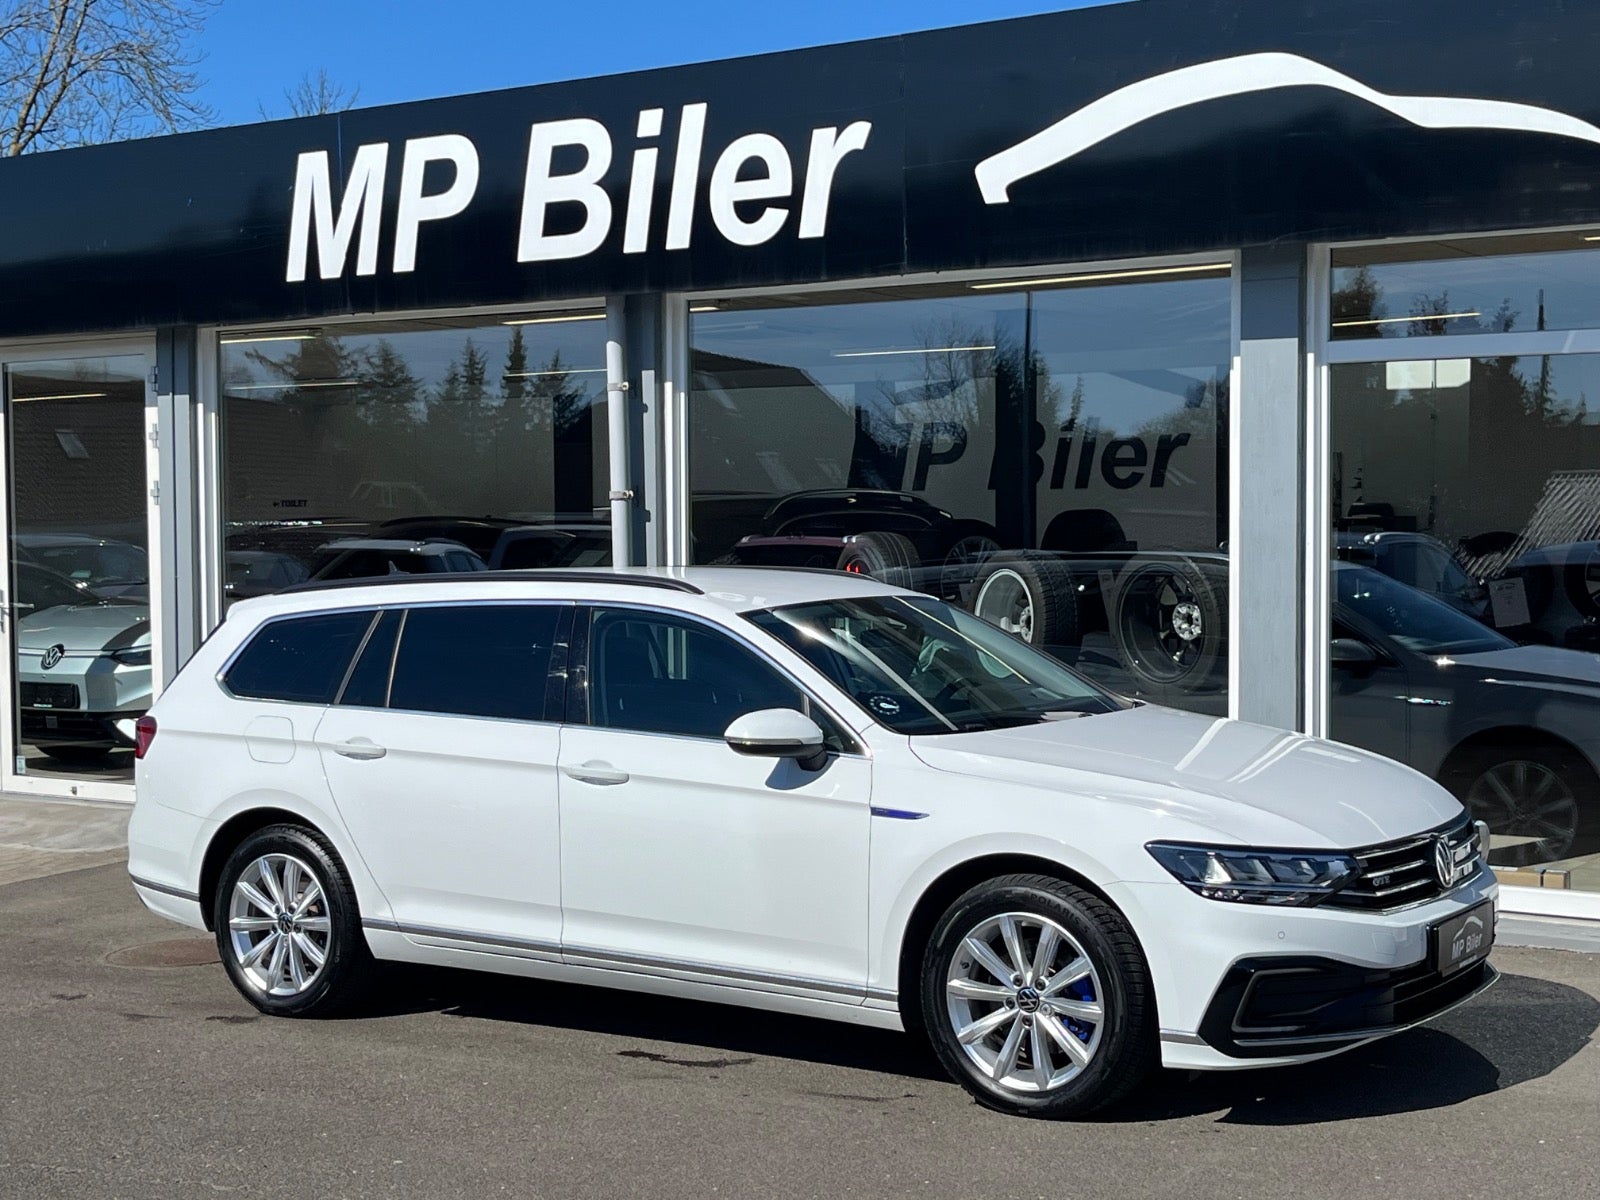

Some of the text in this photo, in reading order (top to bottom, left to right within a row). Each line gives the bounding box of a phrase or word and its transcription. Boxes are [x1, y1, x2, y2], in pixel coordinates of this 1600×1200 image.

[286, 102, 872, 283] MP Biler
[1451, 939, 1465, 961] MP
[1466, 933, 1483, 952] Biler
